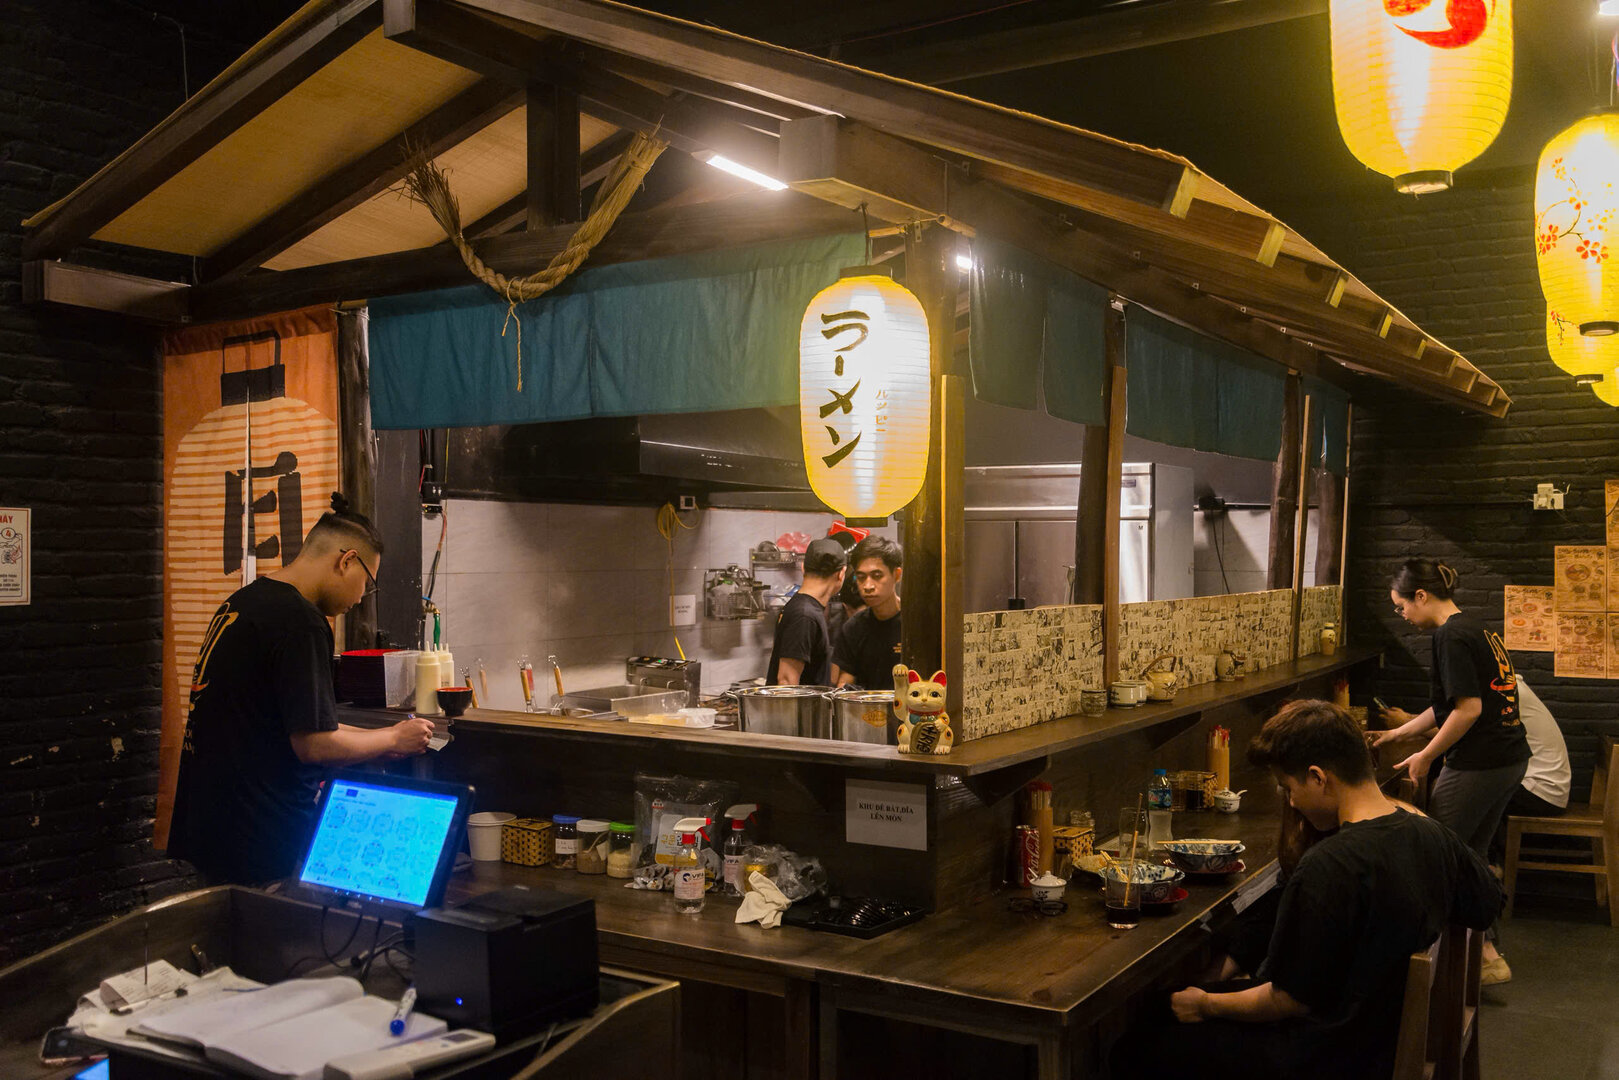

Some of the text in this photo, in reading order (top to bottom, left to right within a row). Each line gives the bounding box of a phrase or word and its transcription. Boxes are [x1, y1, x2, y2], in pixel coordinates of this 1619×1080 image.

[819, 310, 870, 468] ラーメン
[859, 802, 874, 810] KHU
